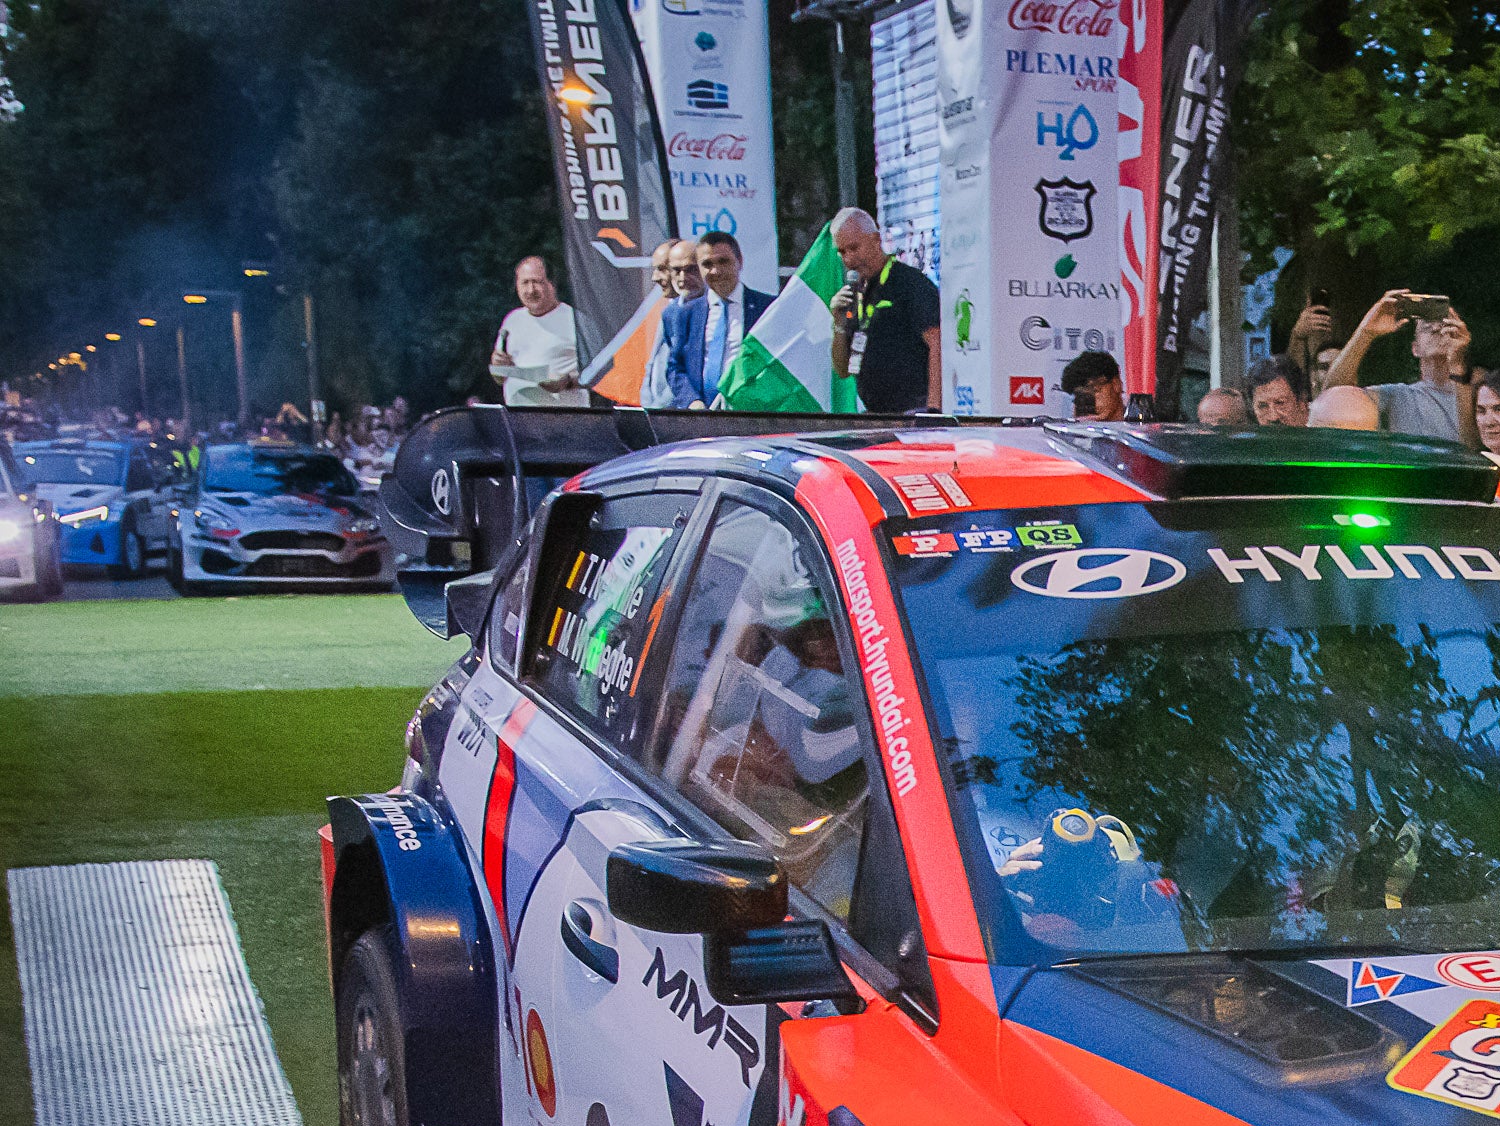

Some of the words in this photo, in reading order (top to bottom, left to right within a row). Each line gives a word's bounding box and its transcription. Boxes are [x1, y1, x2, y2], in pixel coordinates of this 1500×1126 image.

[1006, 49, 1115, 78] PLEMAR
[1073, 78, 1118, 93] SPOR
[911, 536, 939, 553] P
[959, 529, 1013, 548] FP
[1027, 527, 1073, 543] QS
[836, 538, 918, 797] motorsport.hyundai.com
[641, 946, 761, 1091] MMR
